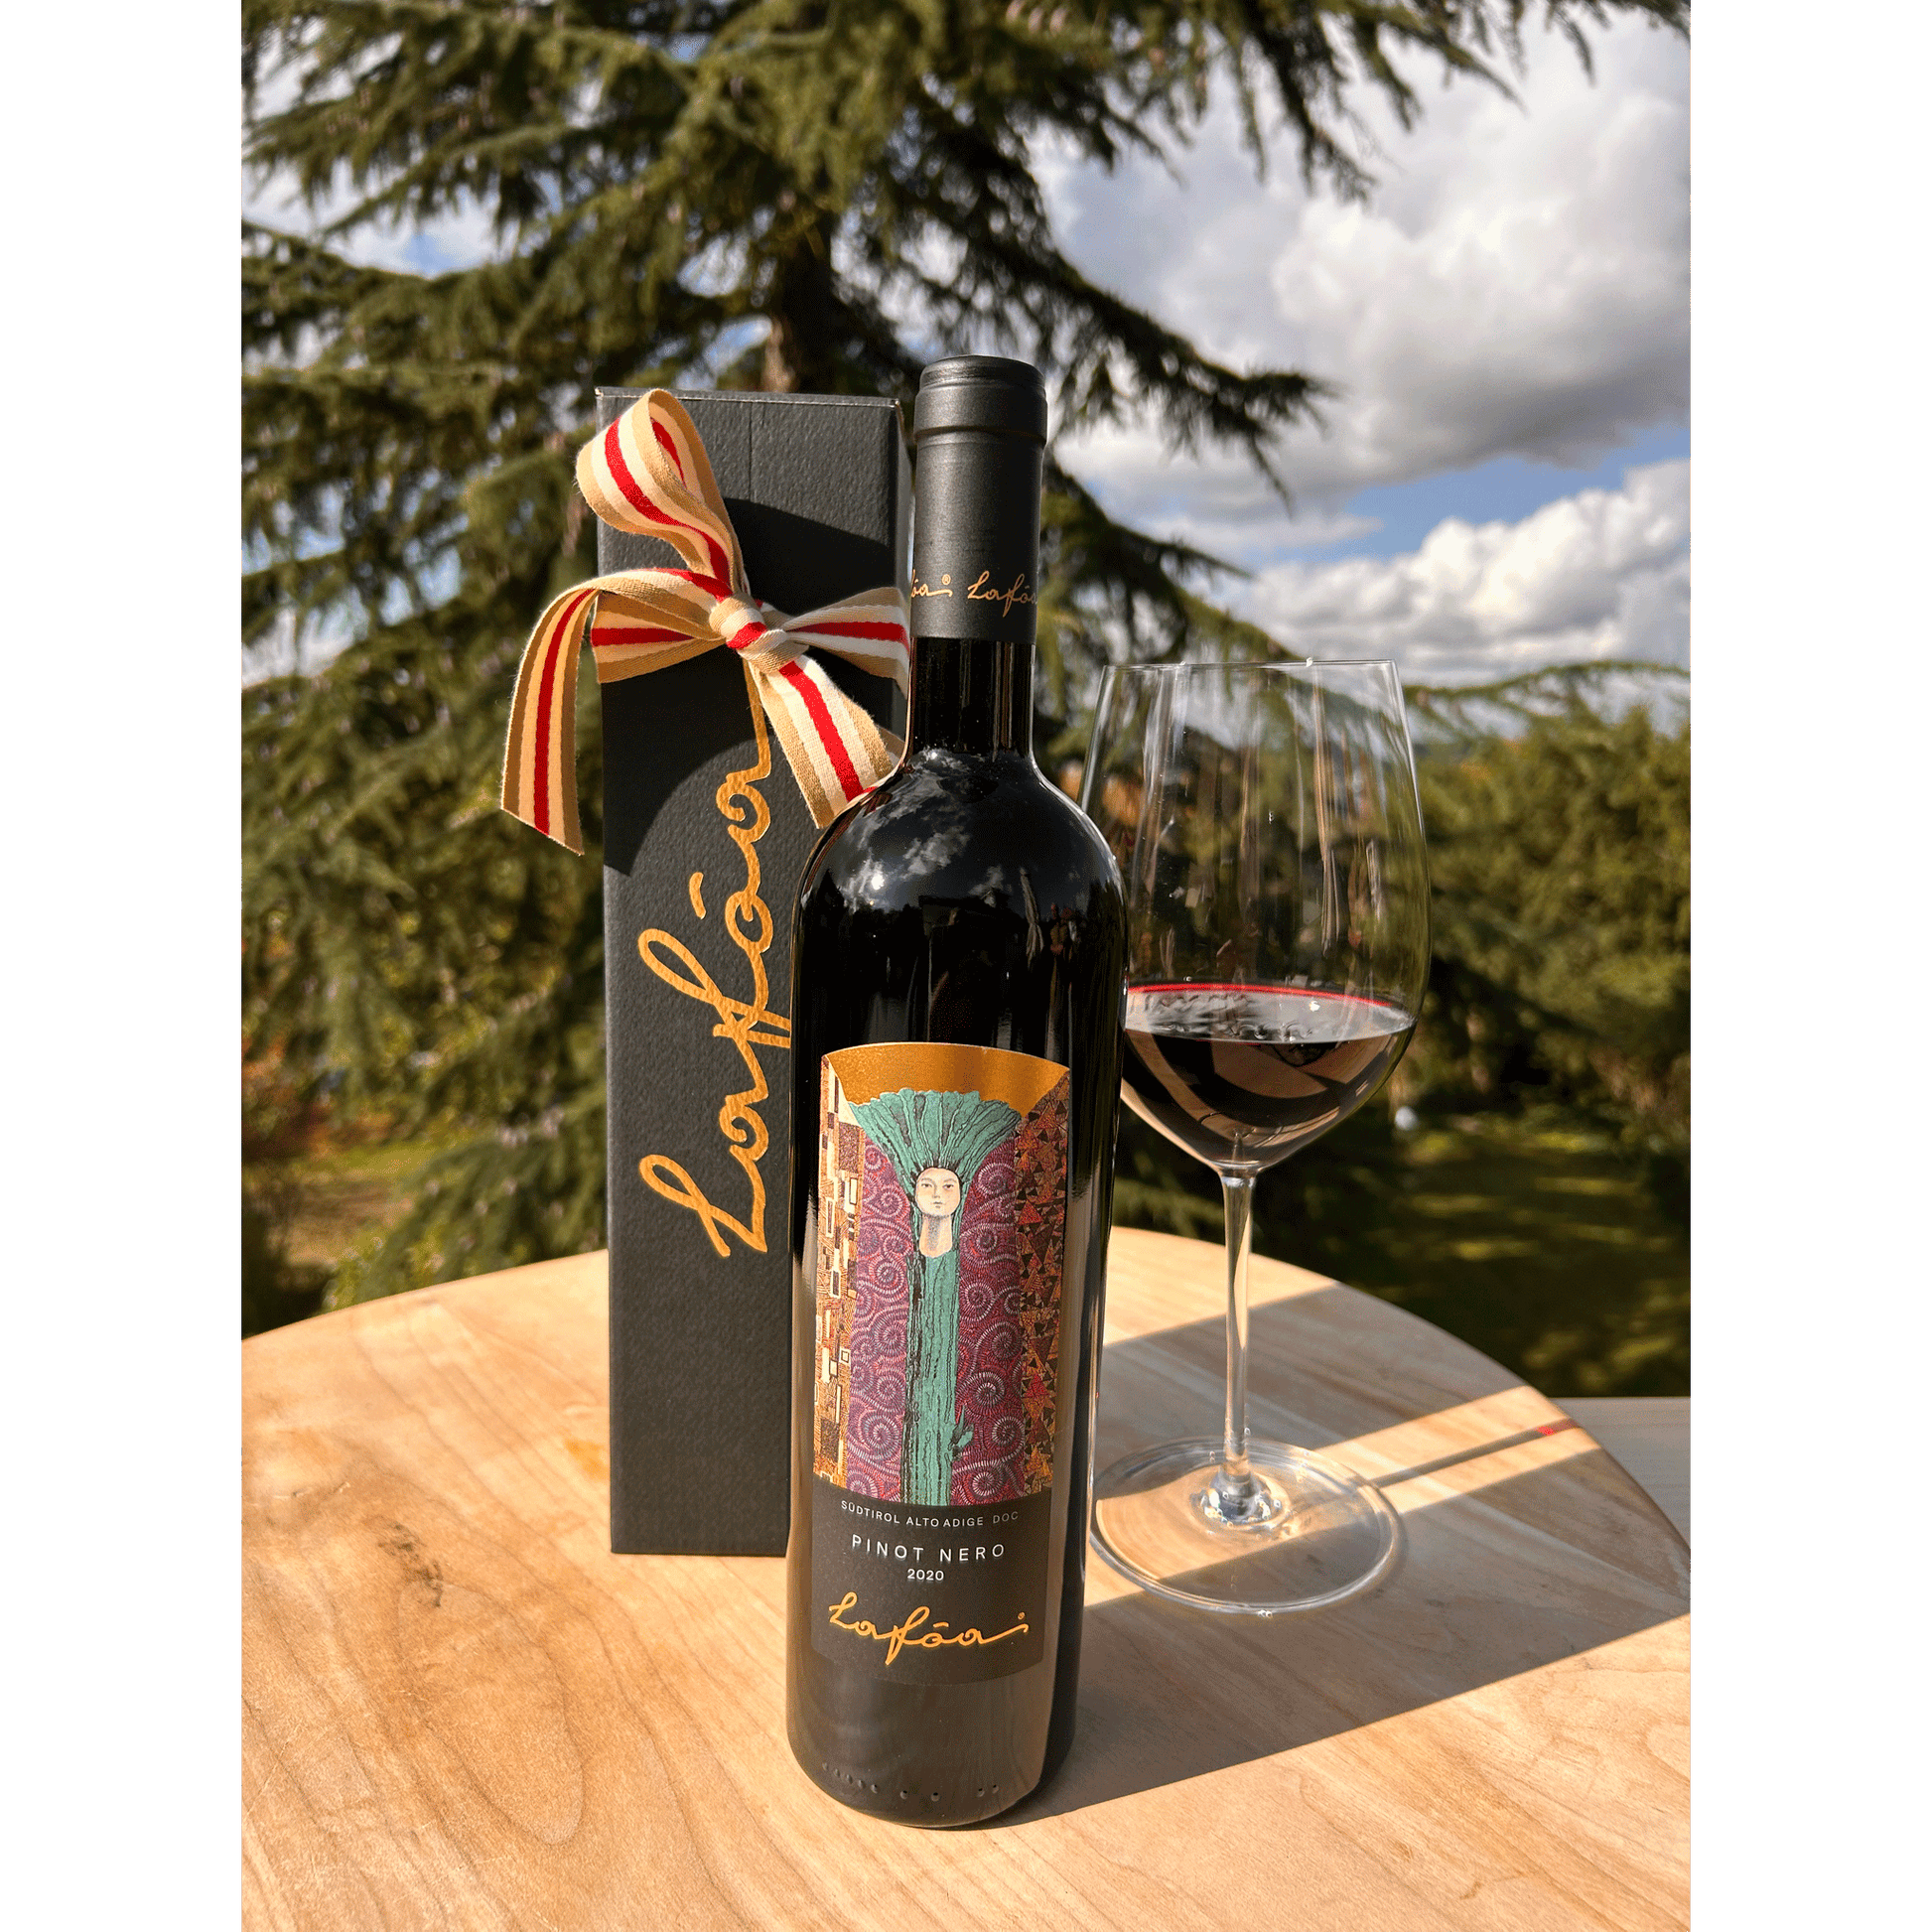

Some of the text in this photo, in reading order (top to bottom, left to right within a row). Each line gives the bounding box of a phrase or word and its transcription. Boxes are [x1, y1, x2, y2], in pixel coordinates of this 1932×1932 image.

[841, 1500, 1019, 1528] SÜDTIROL ALTO ADIGE DOC
[852, 1534, 1005, 1563] PINOT NERO
[906, 1568, 944, 1582] 2020
